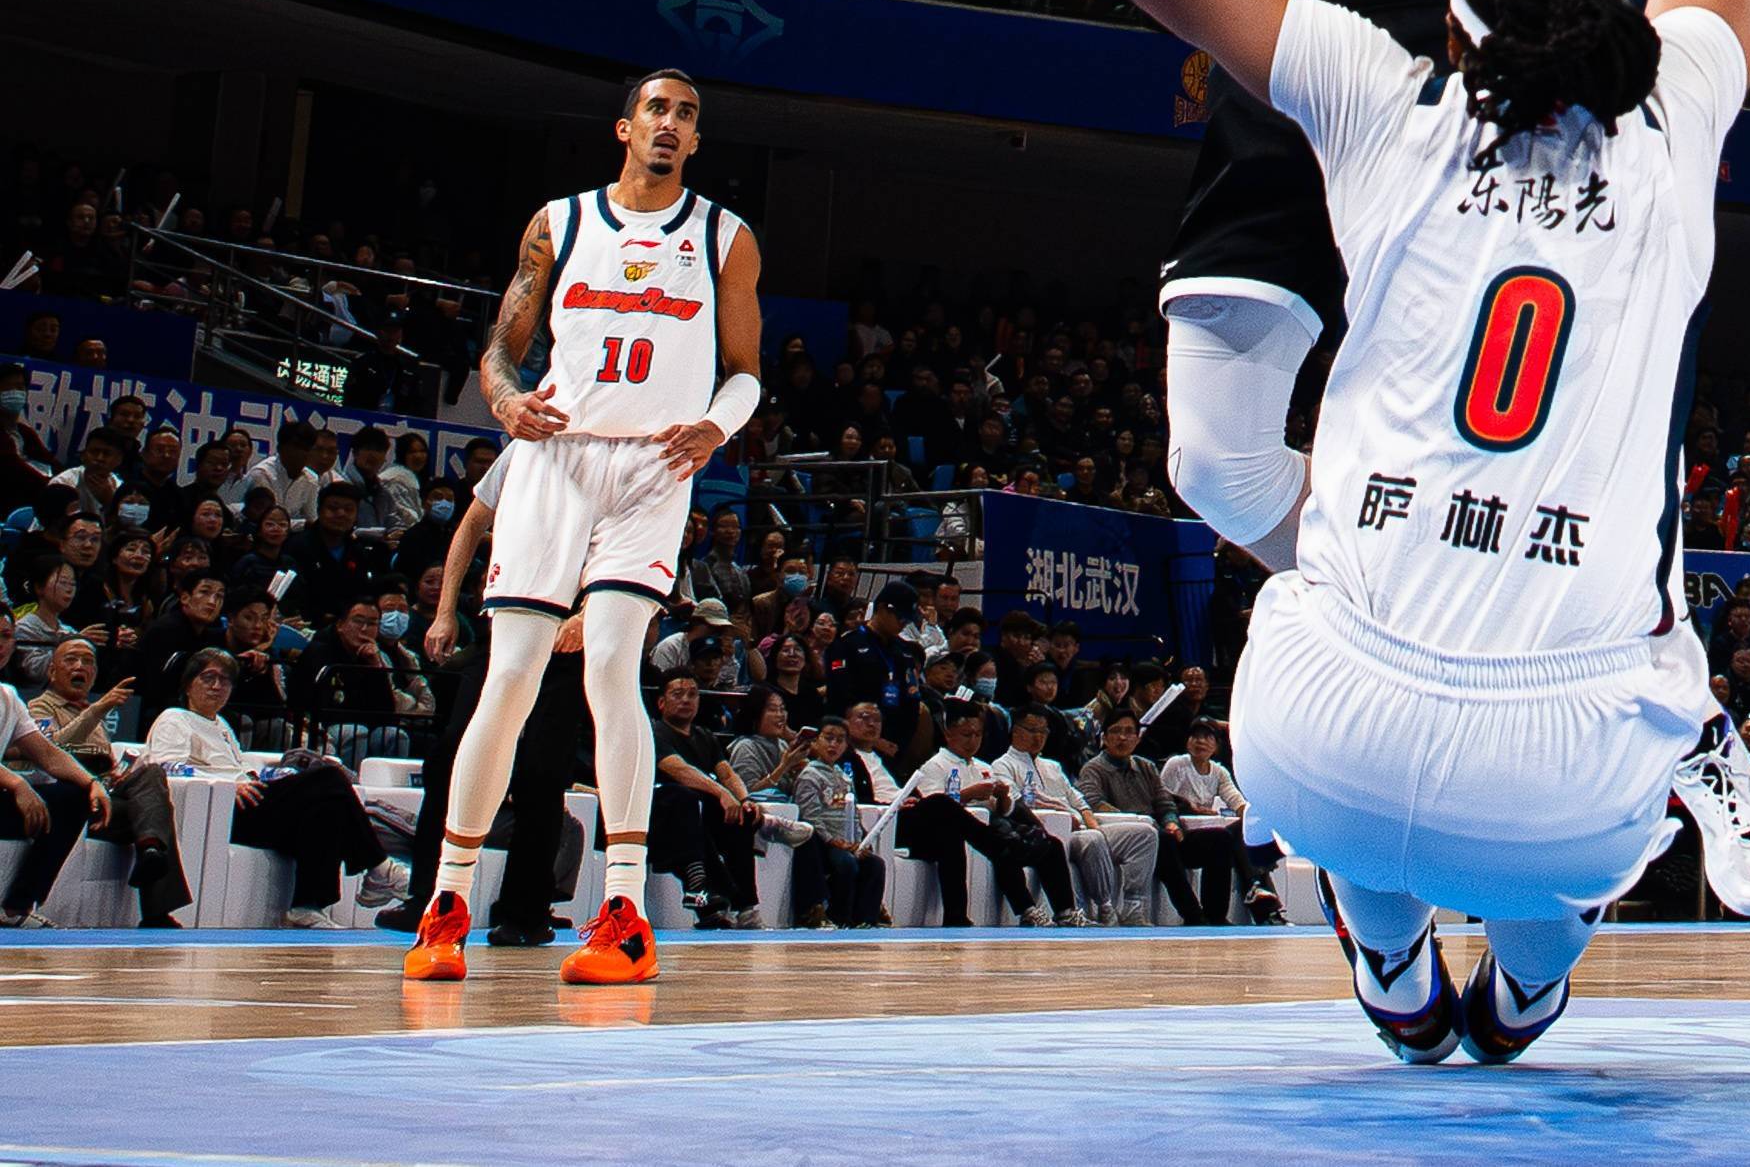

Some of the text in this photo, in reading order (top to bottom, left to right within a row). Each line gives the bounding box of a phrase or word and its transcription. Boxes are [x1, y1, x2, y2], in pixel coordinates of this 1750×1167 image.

[596, 336, 654, 384] 10
[1453, 265, 1577, 453] 0
[1357, 473, 1590, 567] 萨林杰
[1026, 547, 1140, 617] 湖北武汉
